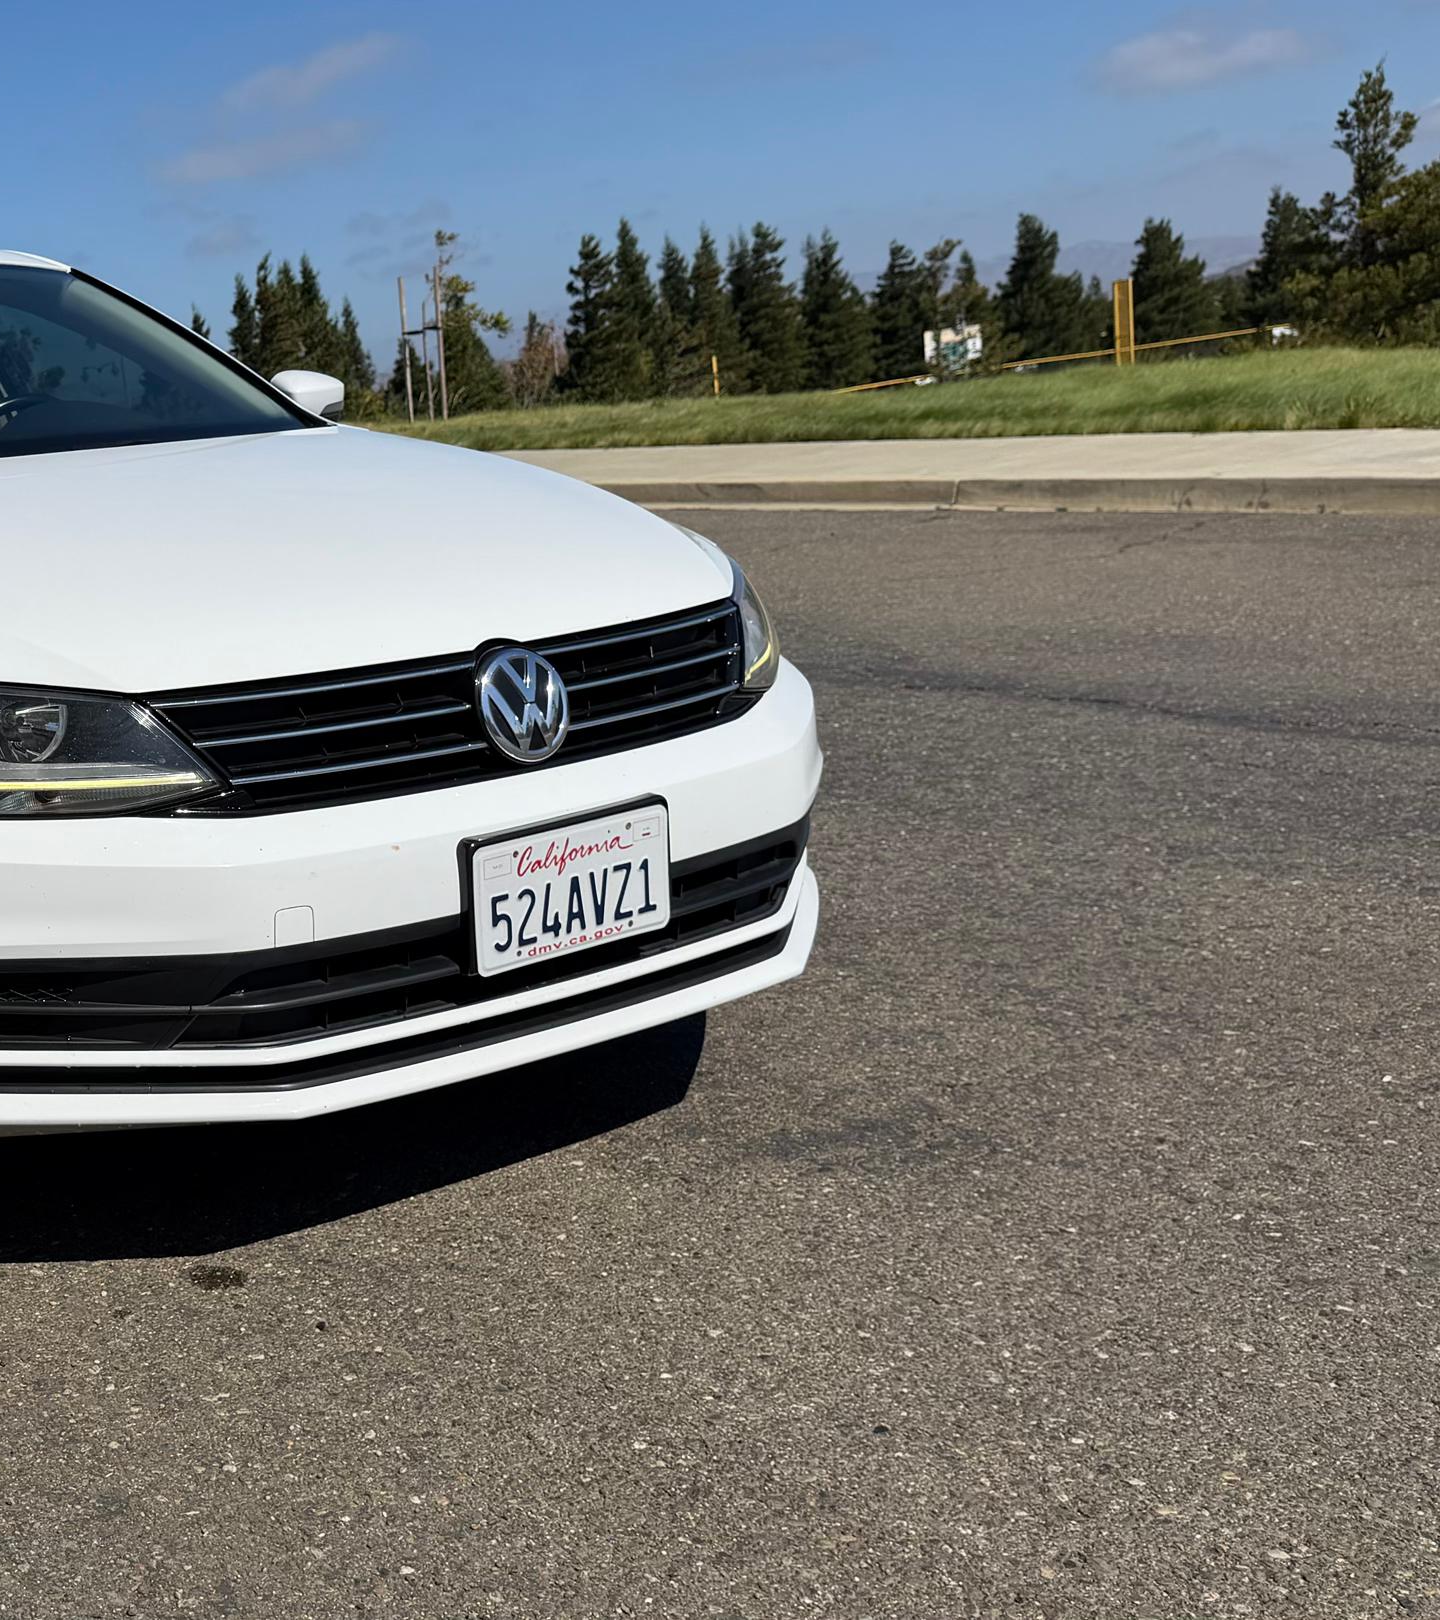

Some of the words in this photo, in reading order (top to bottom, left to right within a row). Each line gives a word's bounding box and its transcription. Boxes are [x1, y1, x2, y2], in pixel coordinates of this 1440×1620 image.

[517, 831, 633, 877] California
[491, 858, 656, 952] 524AVZ1
[527, 924, 624, 957] dmv.ca.gov
